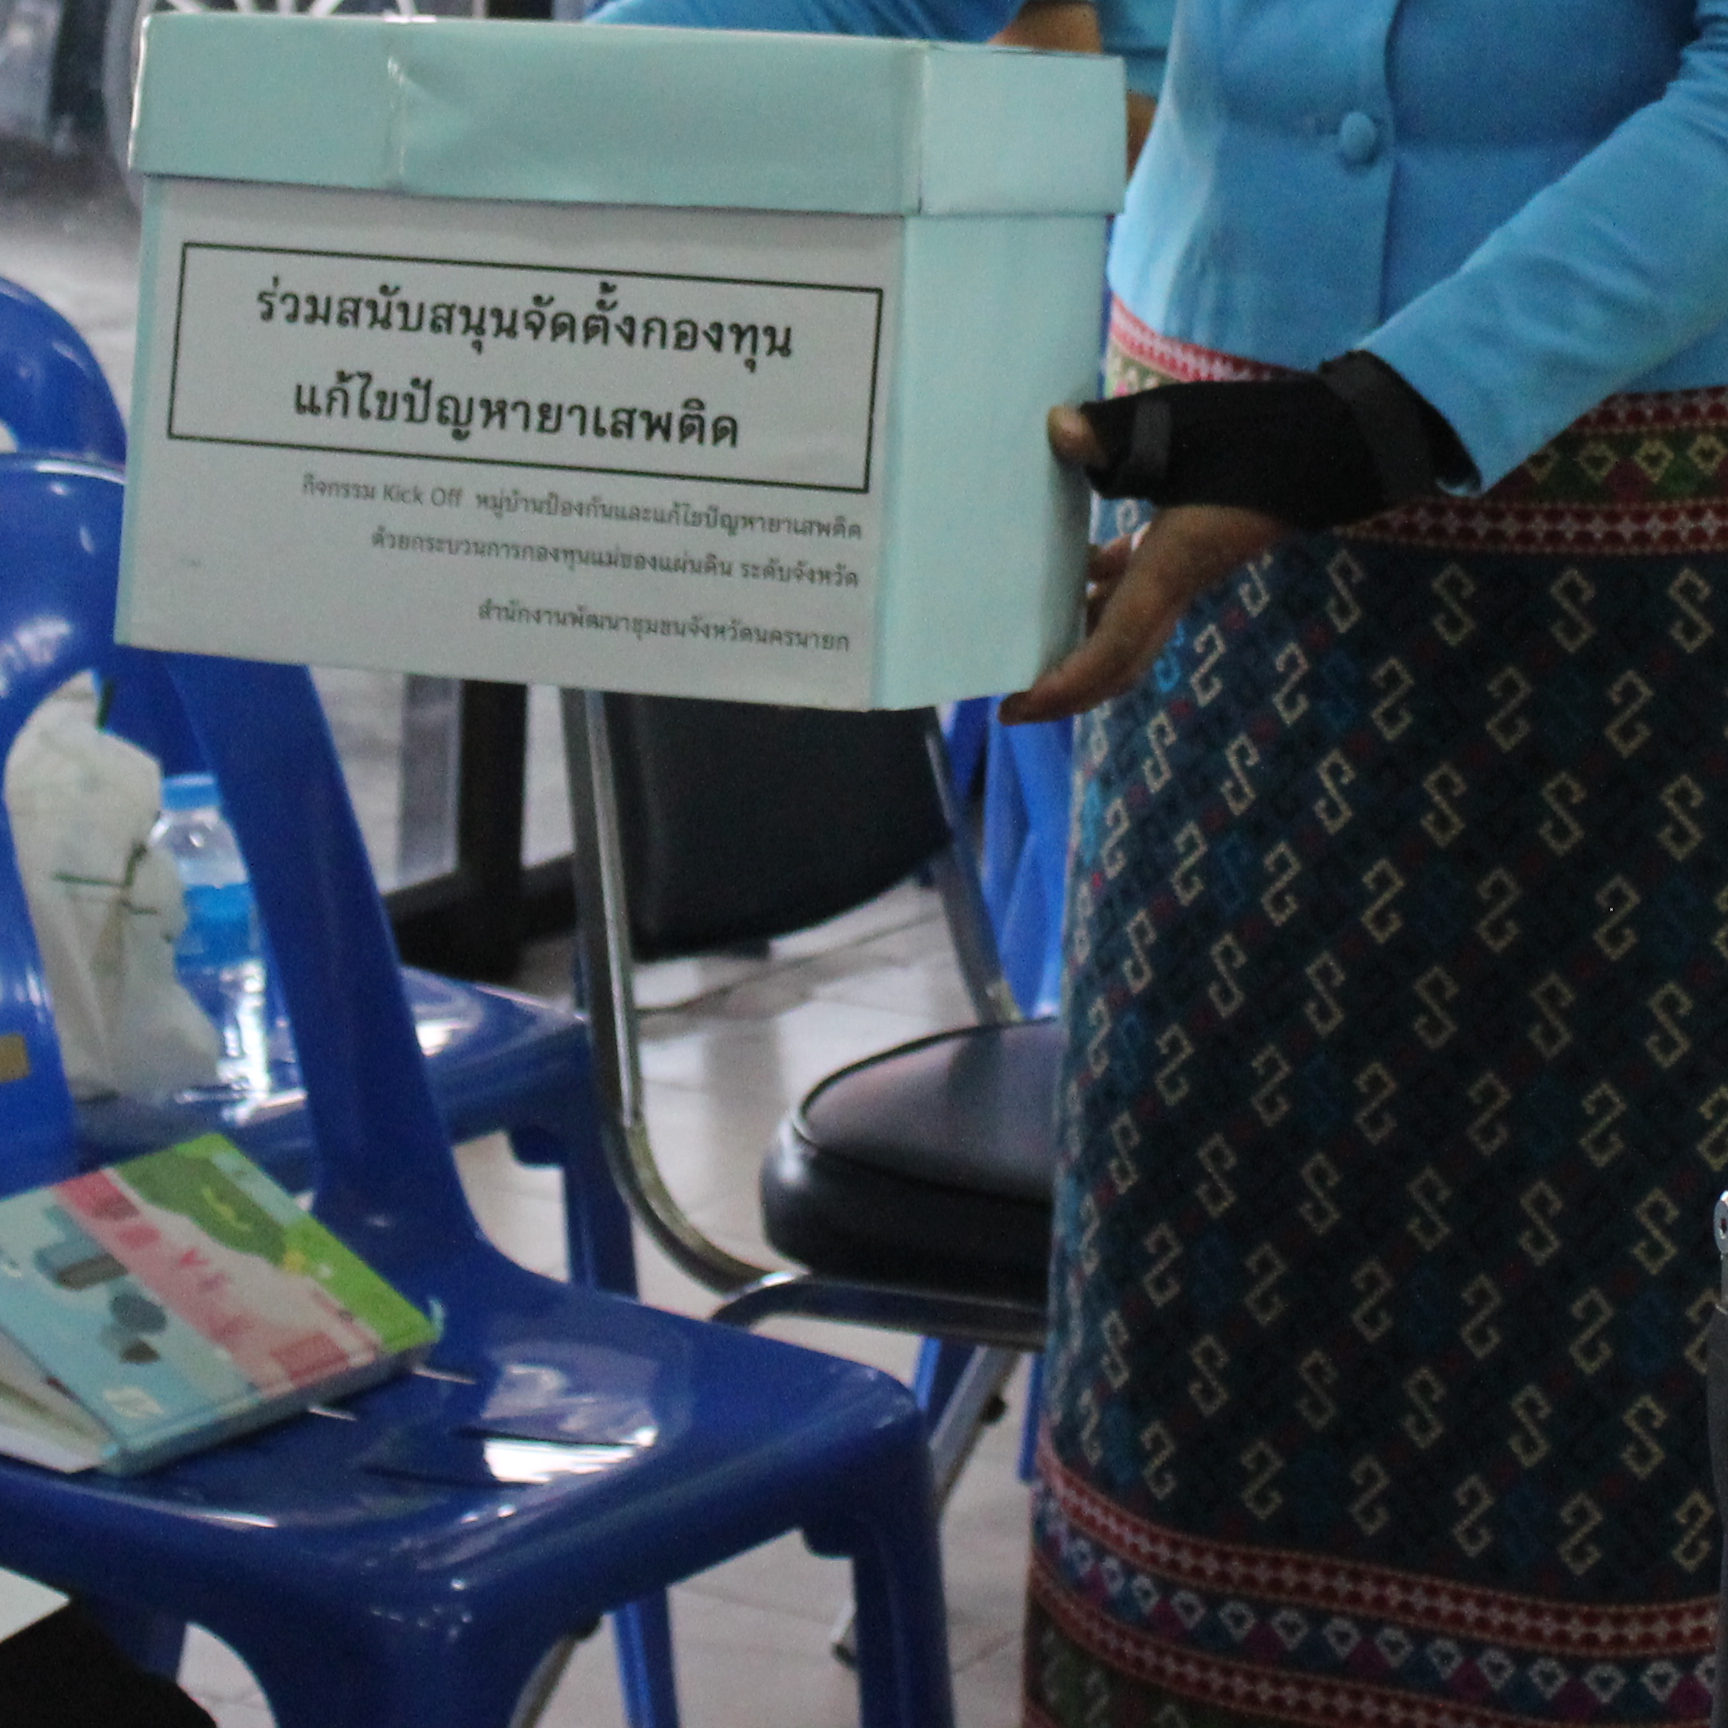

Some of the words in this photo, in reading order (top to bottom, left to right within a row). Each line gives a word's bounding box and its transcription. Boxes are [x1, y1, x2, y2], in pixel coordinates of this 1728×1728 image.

[256, 275, 793, 373] ร่วมสนับสนุนจัดตั้งกองทุน
[294, 369, 739, 448] แก้ไขปัญหายาเสพติด
[302, 472, 376, 501] กิจกรรม
[383, 485, 424, 506] Kick
[431, 487, 463, 508] Off
[741, 557, 859, 588] ระดับจังหวัด
